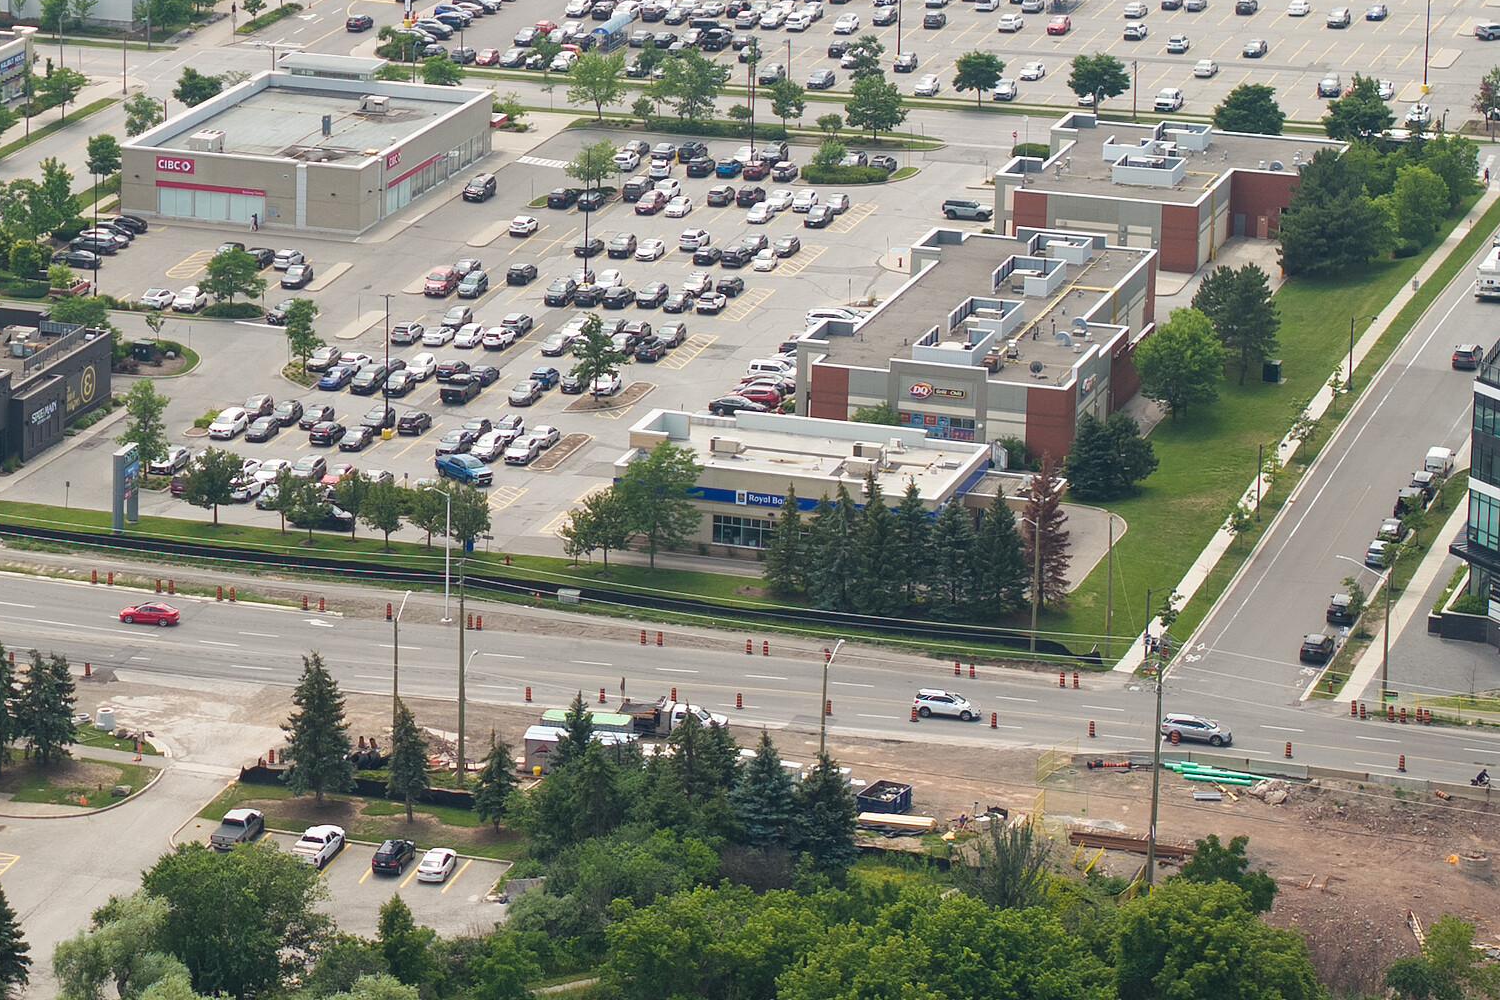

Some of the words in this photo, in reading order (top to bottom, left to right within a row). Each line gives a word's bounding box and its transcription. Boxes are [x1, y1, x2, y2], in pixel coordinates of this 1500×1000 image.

[158, 159, 181, 170] CIBC
[913, 385, 929, 396] DQ
[748, 493, 771, 506] Royal
[772, 496, 788, 506] Ba
